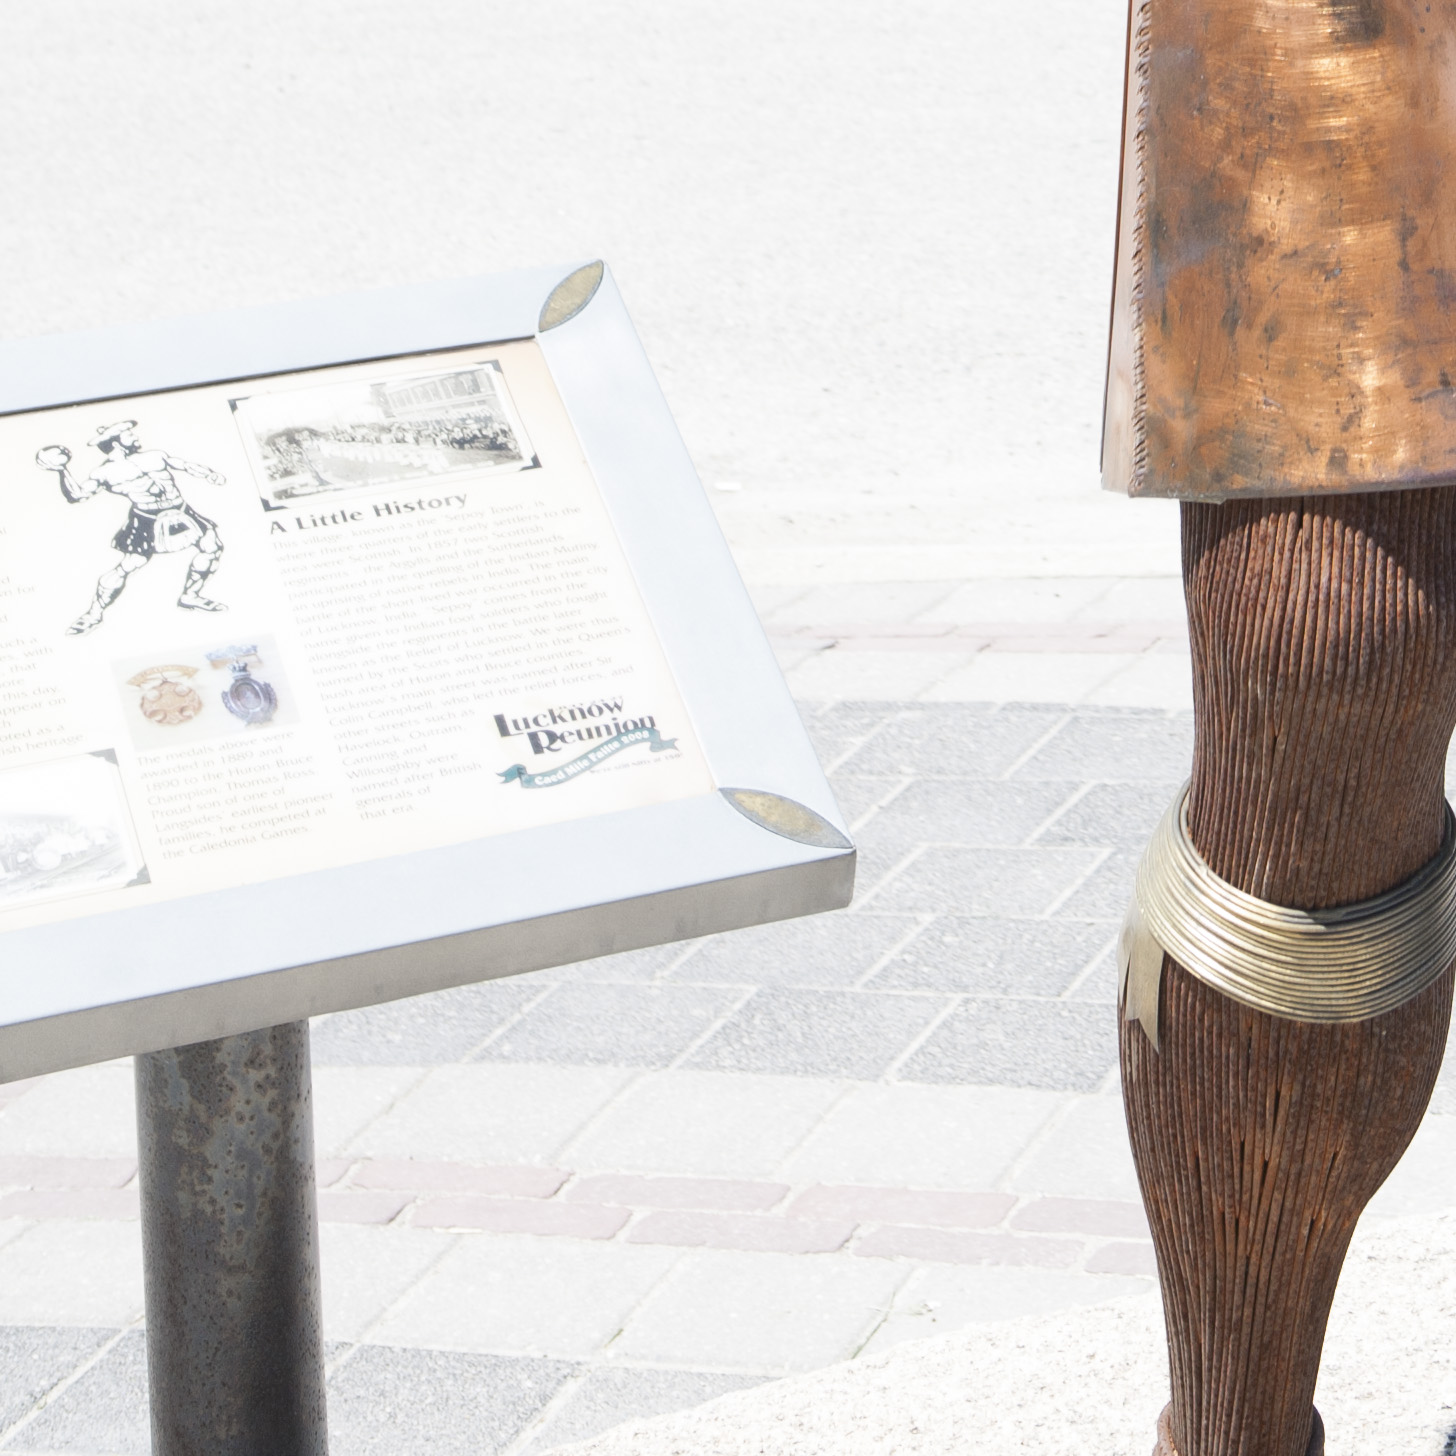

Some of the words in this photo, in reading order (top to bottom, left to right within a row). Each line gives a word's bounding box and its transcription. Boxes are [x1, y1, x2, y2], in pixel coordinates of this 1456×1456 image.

[270, 520, 286, 534] A
[295, 510, 363, 530] Little
[372, 494, 470, 518] History
[273, 540, 297, 549] This
[351, 526, 395, 537] known
[417, 518, 437, 526] the
[276, 551, 315, 561] where
[320, 545, 354, 554] three
[358, 535, 412, 550] quarters
[433, 528, 454, 536] the
[458, 522, 490, 532] early
[493, 515, 540, 526] settlers
[562, 507, 582, 515] the
[280, 565, 308, 574] area
[312, 559, 344, 568] were
[427, 539, 459, 550] 1857
[464, 536, 489, 544] two
[492, 525, 544, 539] Scottish
[284, 571, 349, 586] regiments
[363, 565, 384, 573] the
[435, 551, 460, 561] and
[463, 548, 484, 557] the
[488, 535, 564, 552] Sutherlands
[288, 579, 368, 601] participated
[387, 574, 408, 582] the
[412, 565, 464, 580] quelling
[484, 558, 505, 566] the
[509, 551, 550, 562] Indian
[295, 612, 333, 623] battle
[355, 605, 377, 613] the
[455, 588, 480, 596] war
[482, 576, 541, 592] occurred
[560, 570, 583, 578] the
[586, 566, 609, 574] city
[312, 594, 366, 609] uprising
[386, 584, 425, 595] native
[430, 576, 469, 588] rebels
[529, 562, 552, 571] The
[556, 556, 590, 566] main
[483, 593, 527, 605] comes
[530, 587, 562, 596] from
[566, 582, 588, 590] the
[304, 638, 342, 649] name
[346, 631, 381, 644] given
[404, 620, 445, 632] Indian
[448, 614, 475, 624] foot
[480, 606, 530, 618] soldiers
[534, 599, 562, 609] who
[565, 591, 607, 604] fought
[308, 645, 371, 661] alongside
[376, 641, 398, 650] the
[403, 629, 468, 645] regiments
[488, 622, 509, 630] the
[512, 614, 550, 626] battle
[553, 610, 582, 619] later
[23, 646, 54, 658] with
[312, 662, 357, 674] known
[380, 654, 401, 662] the
[406, 645, 442, 658] Relief
[530, 628, 551, 636] We
[555, 622, 587, 632] were
[590, 616, 619, 625] thus
[10, 663, 38, 672] that
[317, 673, 364, 687] named
[388, 666, 409, 675] the
[413, 659, 450, 670] Scots
[455, 653, 484, 663] who
[488, 643, 532, 657] settled
[552, 637, 574, 646] the
[320, 688, 353, 700] bush
[358, 684, 387, 693] area
[409, 672, 451, 684] Huron
[455, 665, 481, 676] and
[484, 660, 522, 670] Bruce
[329, 715, 364, 726] Colin
[442, 696, 470, 706] who
[473, 690, 494, 700] led
[498, 687, 520, 696] the
[524, 678, 557, 691] relief
[611, 664, 634, 675] and
[401, 689, 436, 700] main
[440, 681, 477, 693] street
[481, 676, 508, 685] was
[512, 665, 559, 680] named
[562, 661, 593, 671] after
[48, 697, 66, 706] on
[493, 696, 624, 738] Lucknow
[37, 726, 52, 734] as
[334, 728, 369, 740] other
[375, 719, 420, 732] streets
[425, 710, 456, 723] such
[527, 715, 657, 755] Reunion
[138, 755, 161, 765] The
[166, 746, 214, 760] medals
[218, 738, 257, 750] above
[262, 732, 294, 742] were
[140, 761, 199, 778] awarded
[221, 750, 254, 763] 1889
[259, 745, 284, 756] and
[342, 751, 399, 766] Canning
[402, 743, 428, 755] and
[146, 778, 180, 791] 1890
[202, 771, 224, 781] the
[346, 760, 422, 779] Willoughby
[426, 753, 458, 764] were
[351, 777, 399, 792] named
[404, 772, 434, 782] after
[439, 761, 482, 776] British
[227, 776, 279, 790] Thomas
[151, 804, 192, 818] Proud
[196, 800, 221, 810] son
[243, 791, 268, 801] one
[231, 802, 279, 817] earliest
[284, 793, 333, 810] pioneer
[355, 790, 413, 809] generals
[360, 809, 387, 820] that
[241, 809, 311, 829] competed
[162, 849, 185, 858] the
[188, 835, 256, 853] Caledonia
